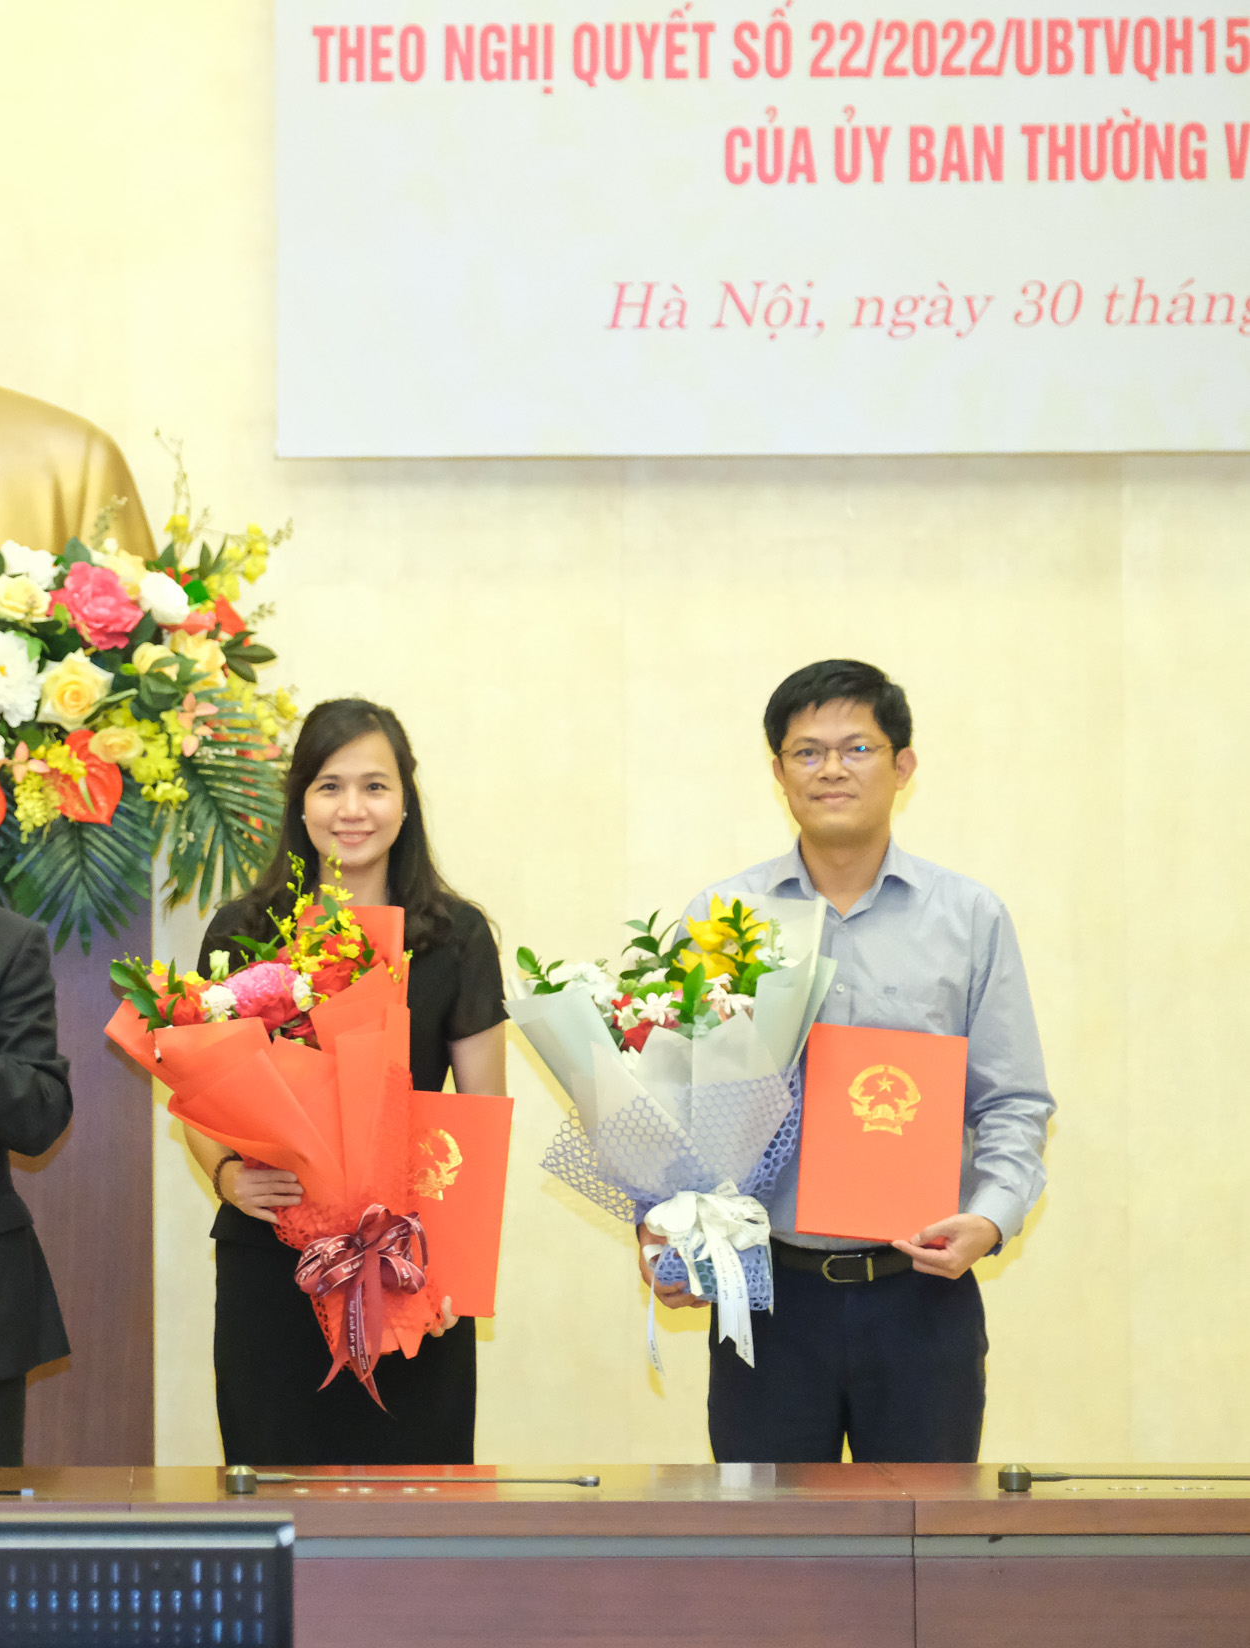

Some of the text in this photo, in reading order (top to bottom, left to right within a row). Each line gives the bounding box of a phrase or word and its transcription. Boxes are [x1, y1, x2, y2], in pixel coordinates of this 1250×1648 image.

[312, 0, 1250, 95] THEO NGHỊ QUYẾT SỐ 22/2022/UBTVQH15
[725, 106, 817, 185] CỦA
[834, 105, 891, 184] ỦY
[909, 125, 1004, 183] BAN
[1021, 108, 1207, 182] THƯỜNG
[605, 282, 687, 330] Hà
[713, 281, 826, 339] Nội,
[851, 282, 992, 338] ngày
[1014, 279, 1083, 327] 30
